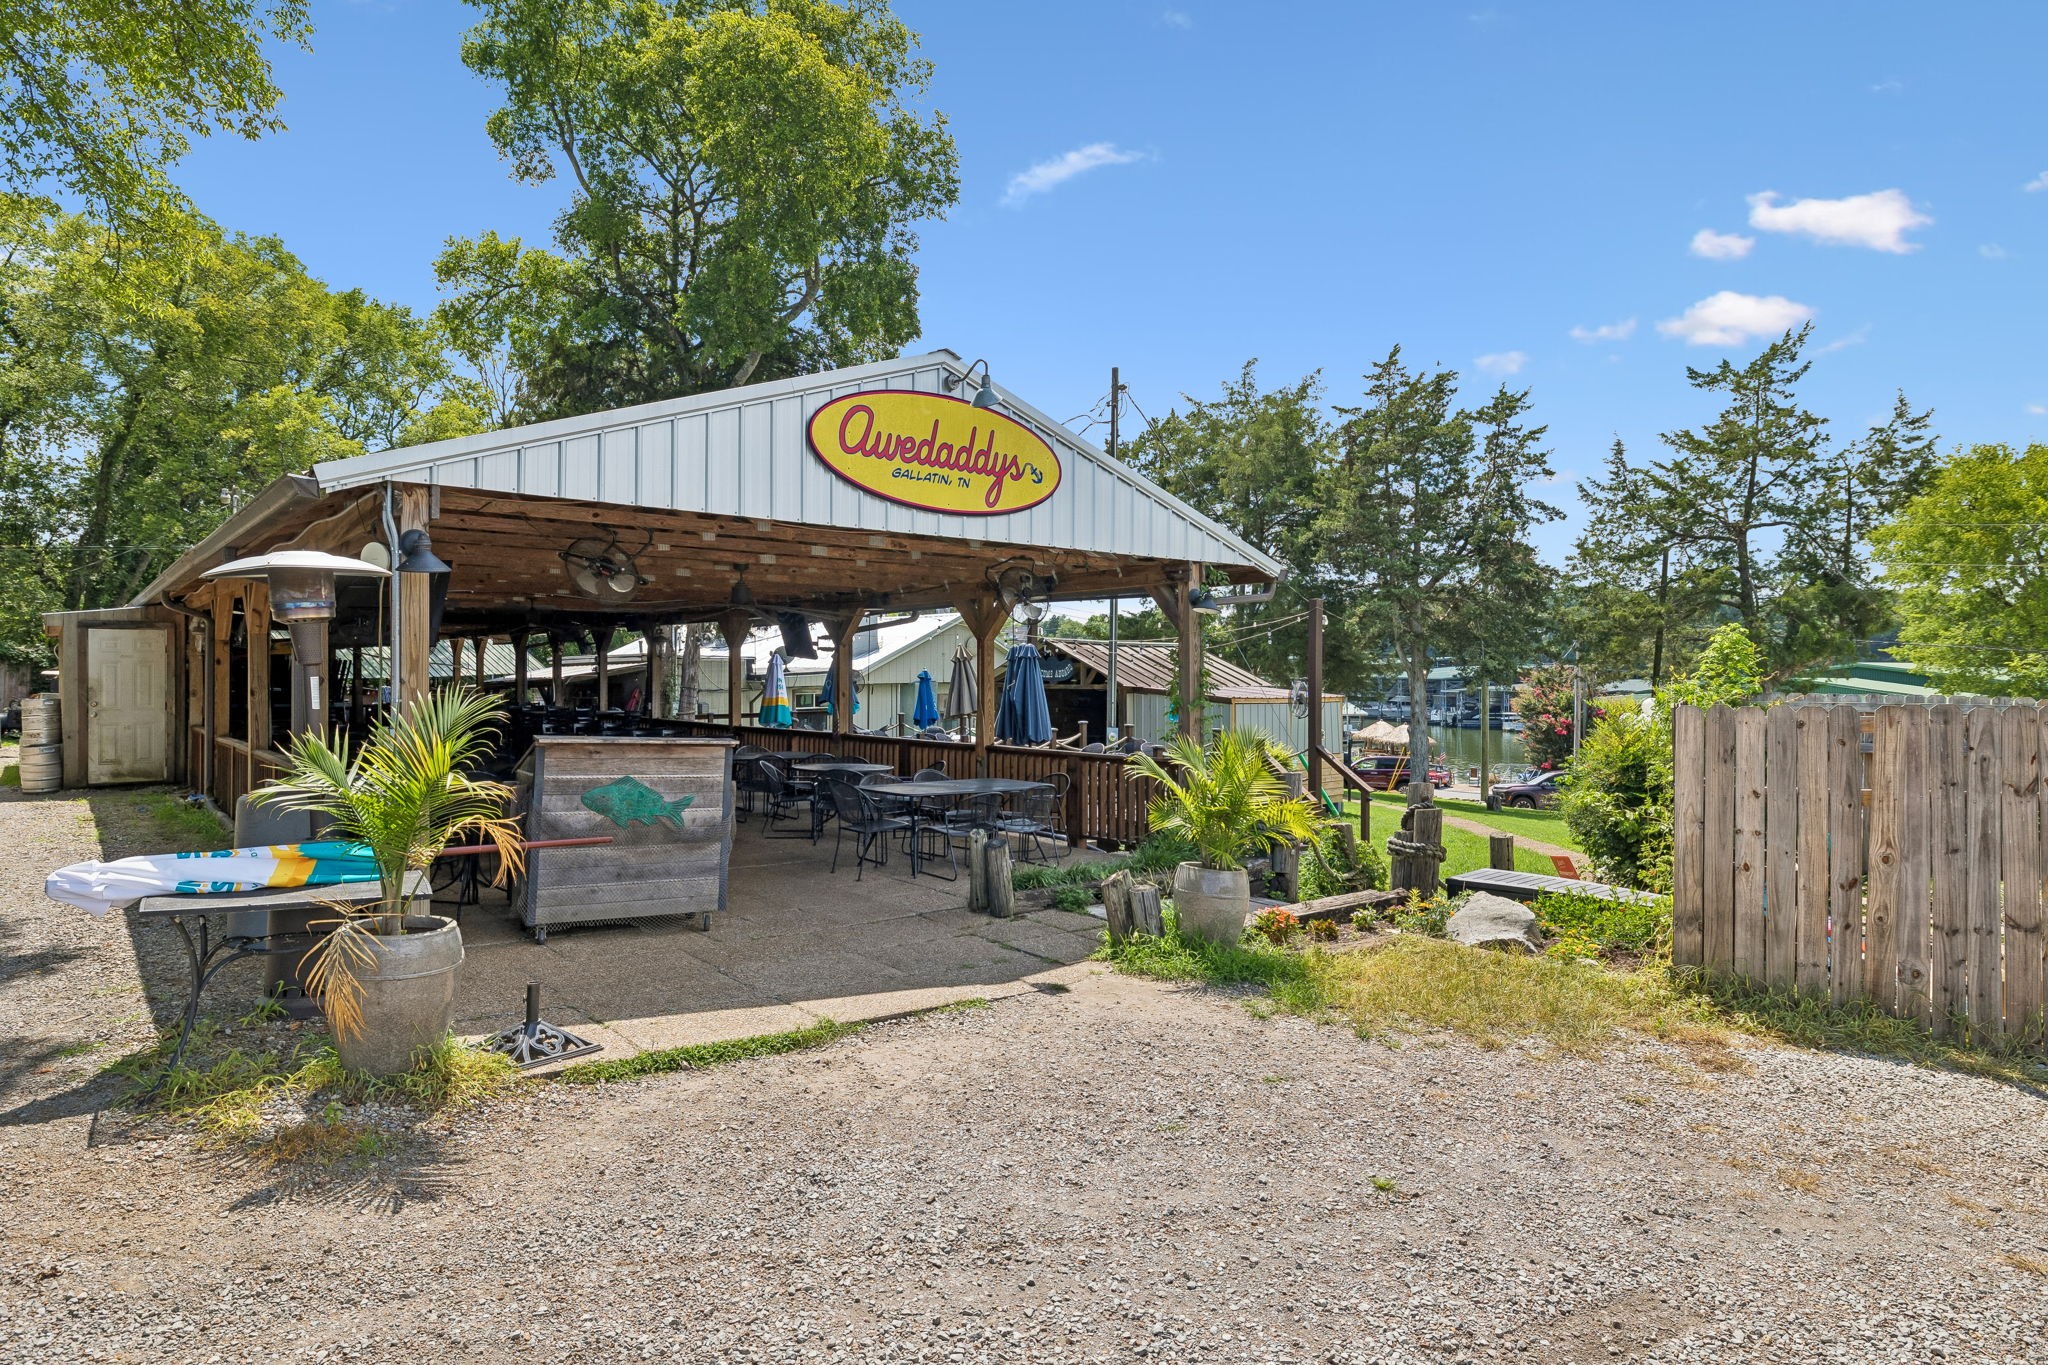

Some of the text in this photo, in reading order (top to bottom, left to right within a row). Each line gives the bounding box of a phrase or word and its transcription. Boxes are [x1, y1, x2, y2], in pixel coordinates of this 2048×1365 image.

[838, 404, 1025, 508] Awedaddys
[891, 467, 971, 488] GALLATIN, TN
